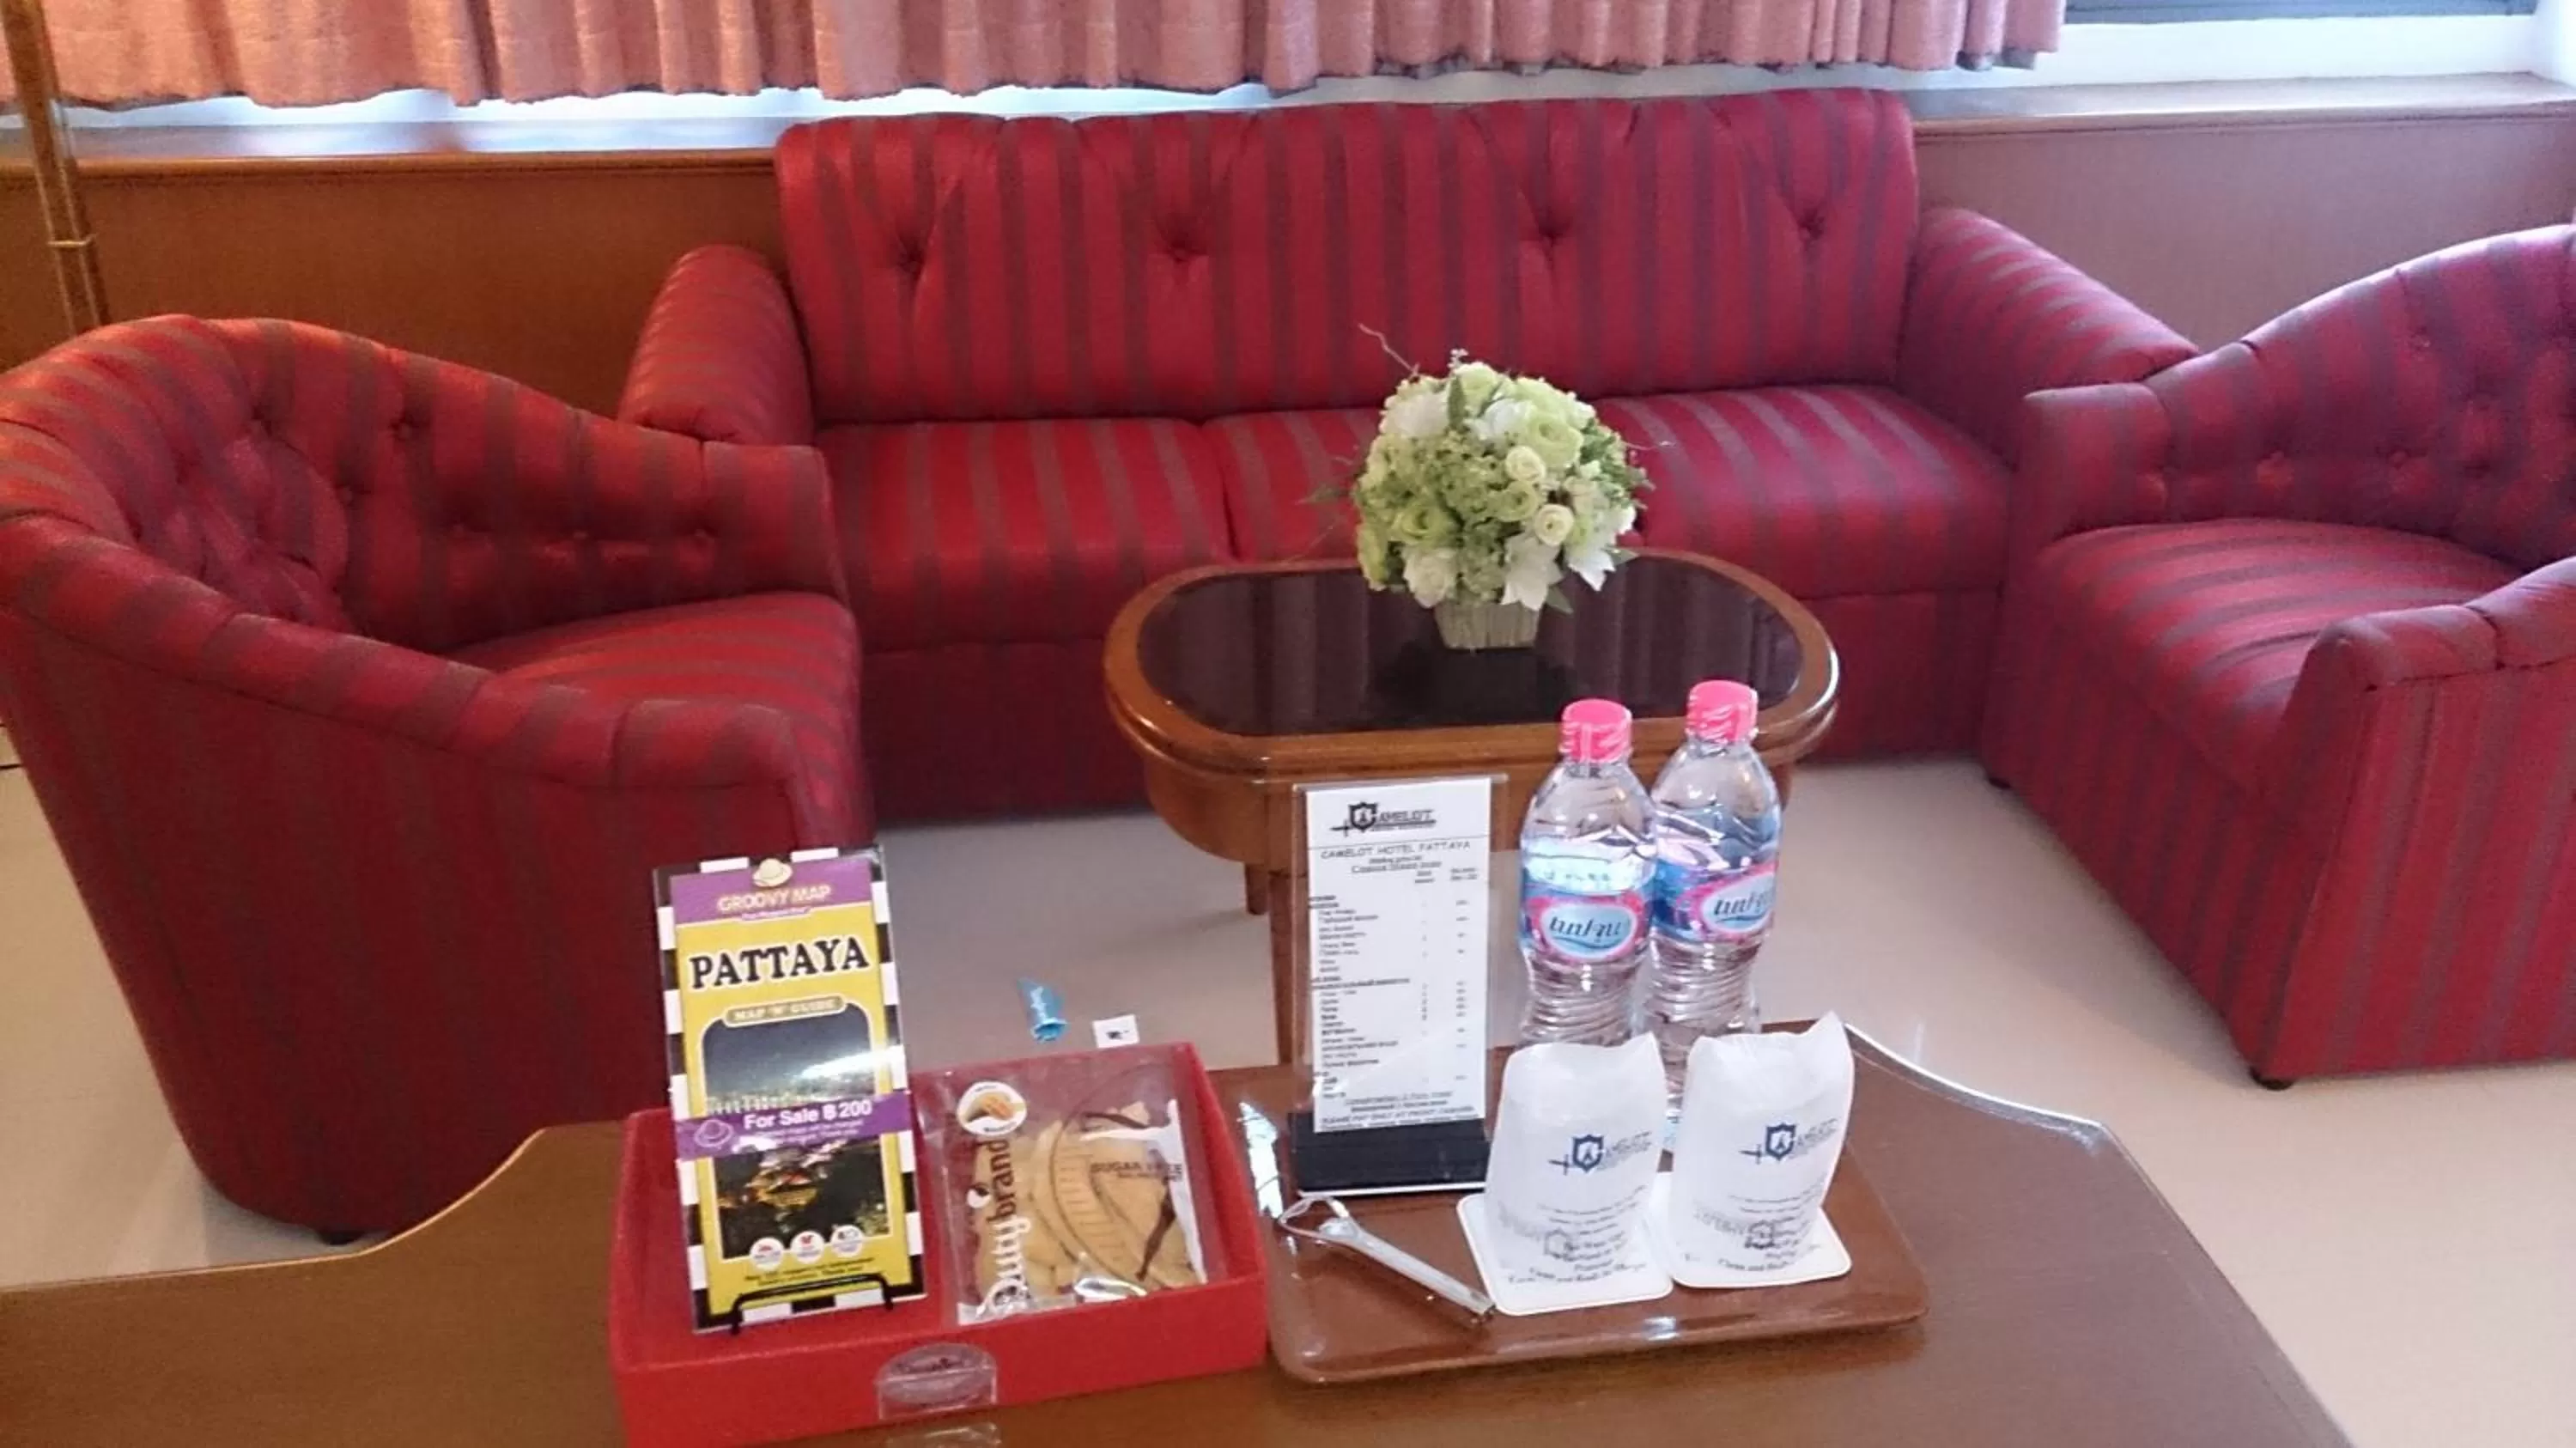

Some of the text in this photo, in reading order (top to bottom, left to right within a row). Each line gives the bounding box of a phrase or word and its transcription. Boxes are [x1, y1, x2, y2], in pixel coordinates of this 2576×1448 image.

[1321, 848, 1373, 860] CAMELOT
[1377, 844, 1415, 855] HOTEL
[717, 885, 832, 913] GROOVY MAP
[689, 937, 870, 989] PATTAYA
[743, 1114, 775, 1130] For
[780, 1108, 819, 1126] Sale
